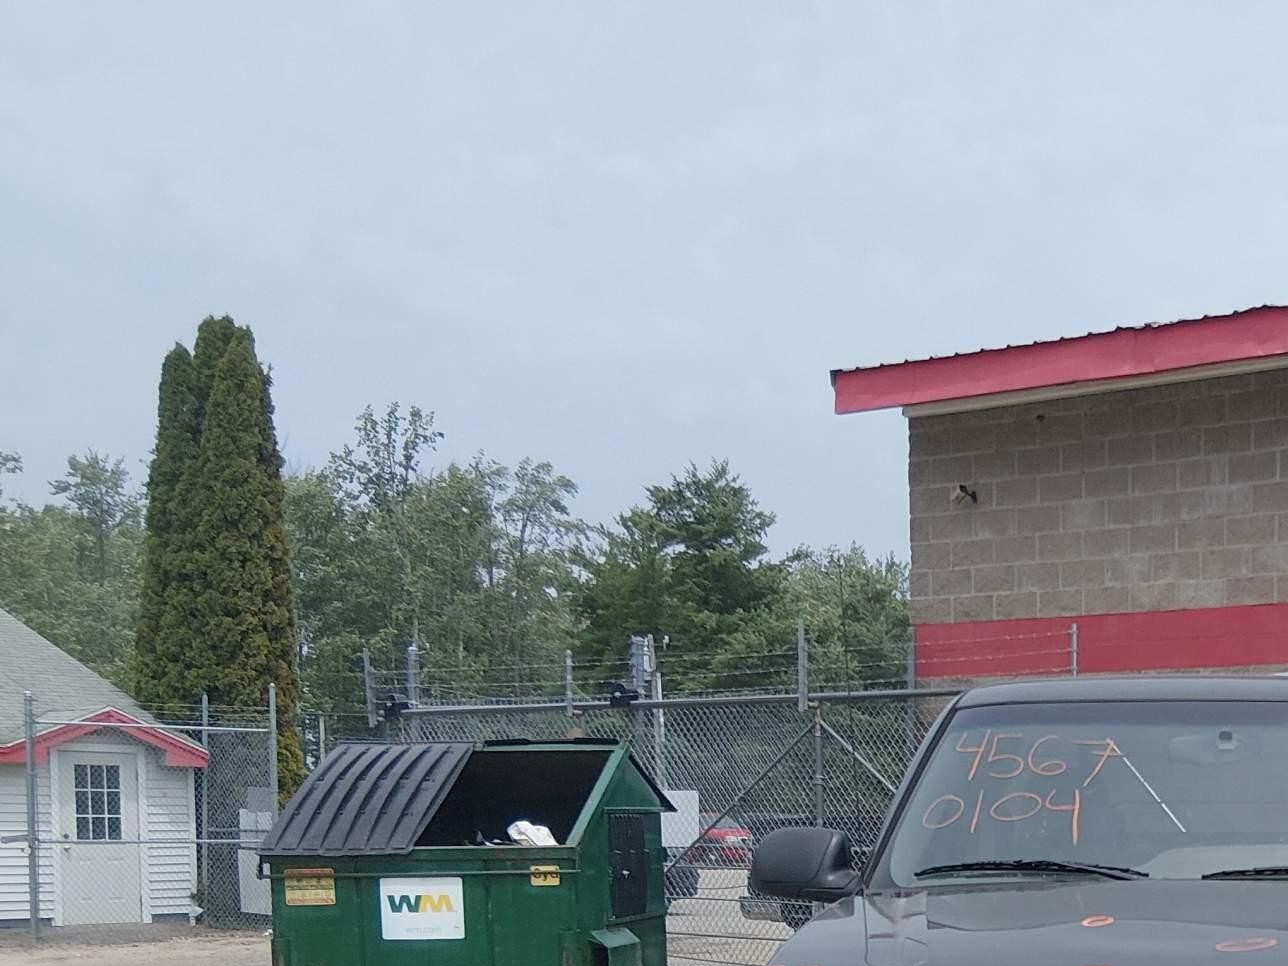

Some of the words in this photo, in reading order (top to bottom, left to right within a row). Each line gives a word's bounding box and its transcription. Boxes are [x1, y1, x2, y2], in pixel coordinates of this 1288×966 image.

[955, 729, 1124, 787] 4567
[922, 788, 1080, 846] 0104
[386, 894, 455, 913] WM
